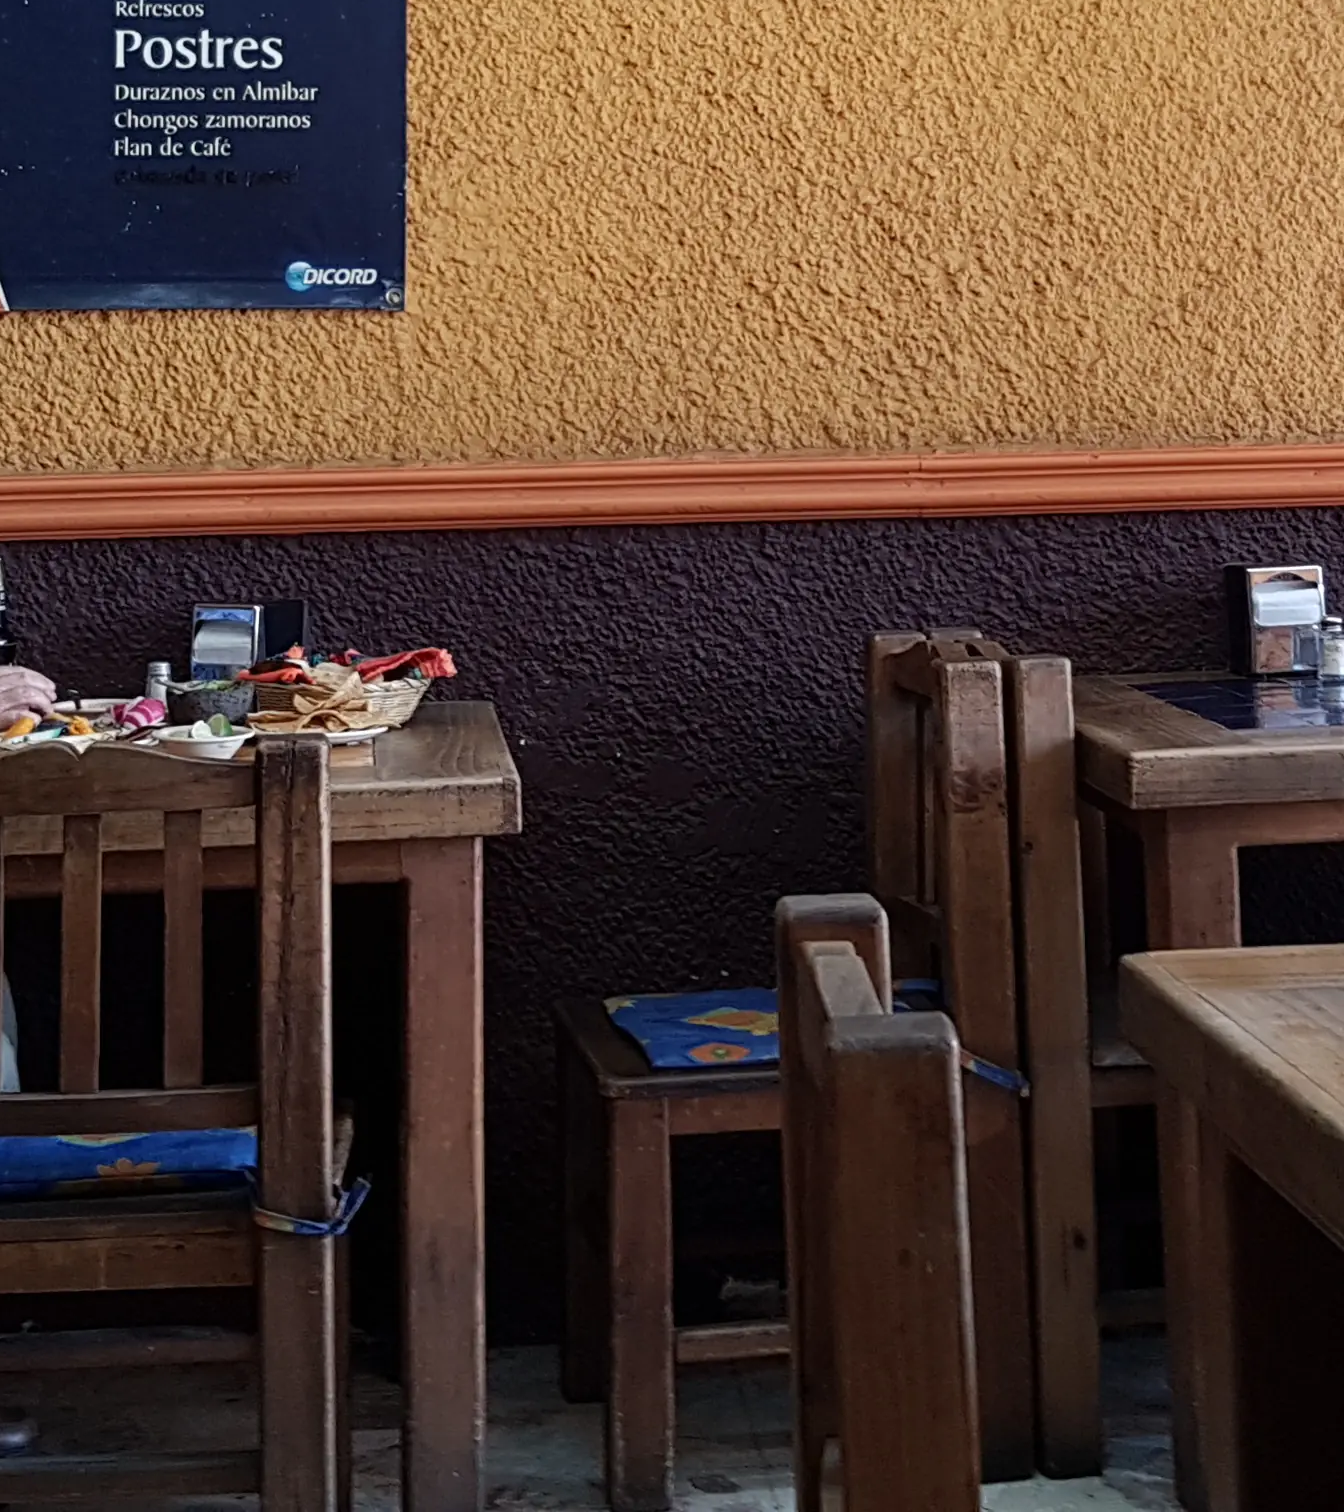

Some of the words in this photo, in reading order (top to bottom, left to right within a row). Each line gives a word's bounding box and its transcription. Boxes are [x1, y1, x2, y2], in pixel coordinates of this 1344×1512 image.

[115, 0, 205, 18] Refrescos
[114, 29, 283, 69] Postres
[114, 84, 205, 100] Duraznos
[212, 86, 235, 100] en
[242, 81, 318, 102] Almibar
[114, 109, 198, 134] Chongos
[205, 113, 311, 129] zamoranos
[114, 137, 153, 156] Flan
[160, 137, 183, 157] de
[190, 137, 231, 157] Café
[303, 268, 377, 285] DICORD
